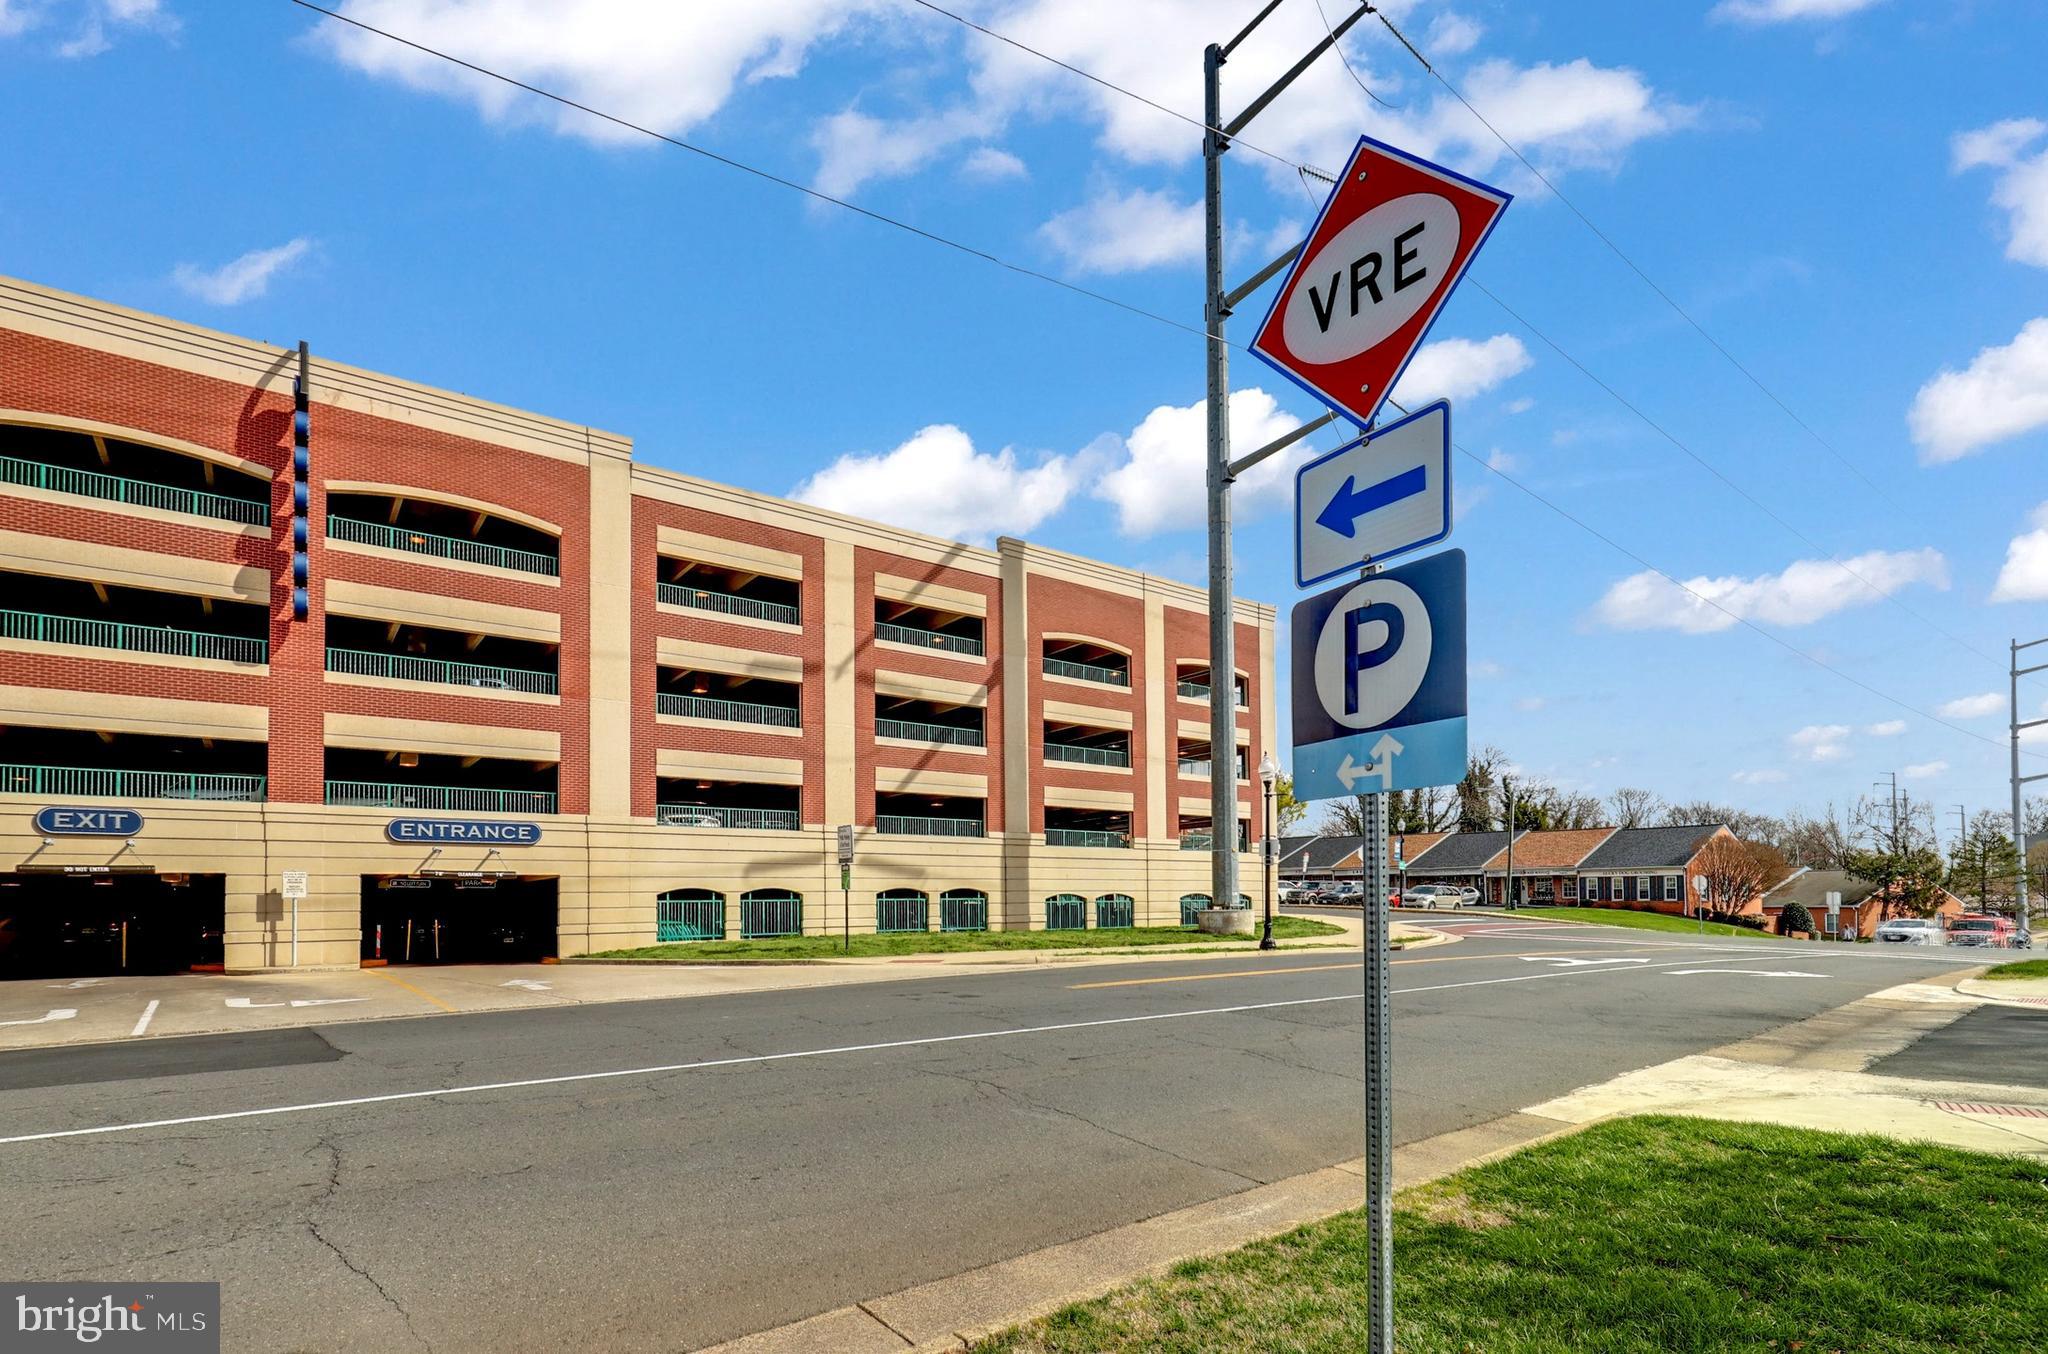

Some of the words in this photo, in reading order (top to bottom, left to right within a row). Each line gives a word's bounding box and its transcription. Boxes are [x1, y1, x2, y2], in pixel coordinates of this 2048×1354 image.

[1308, 221, 1427, 334] VRE
[1344, 602, 1405, 716] P
[53, 812, 129, 829] EXIT
[400, 823, 532, 839] ENTRANCE
